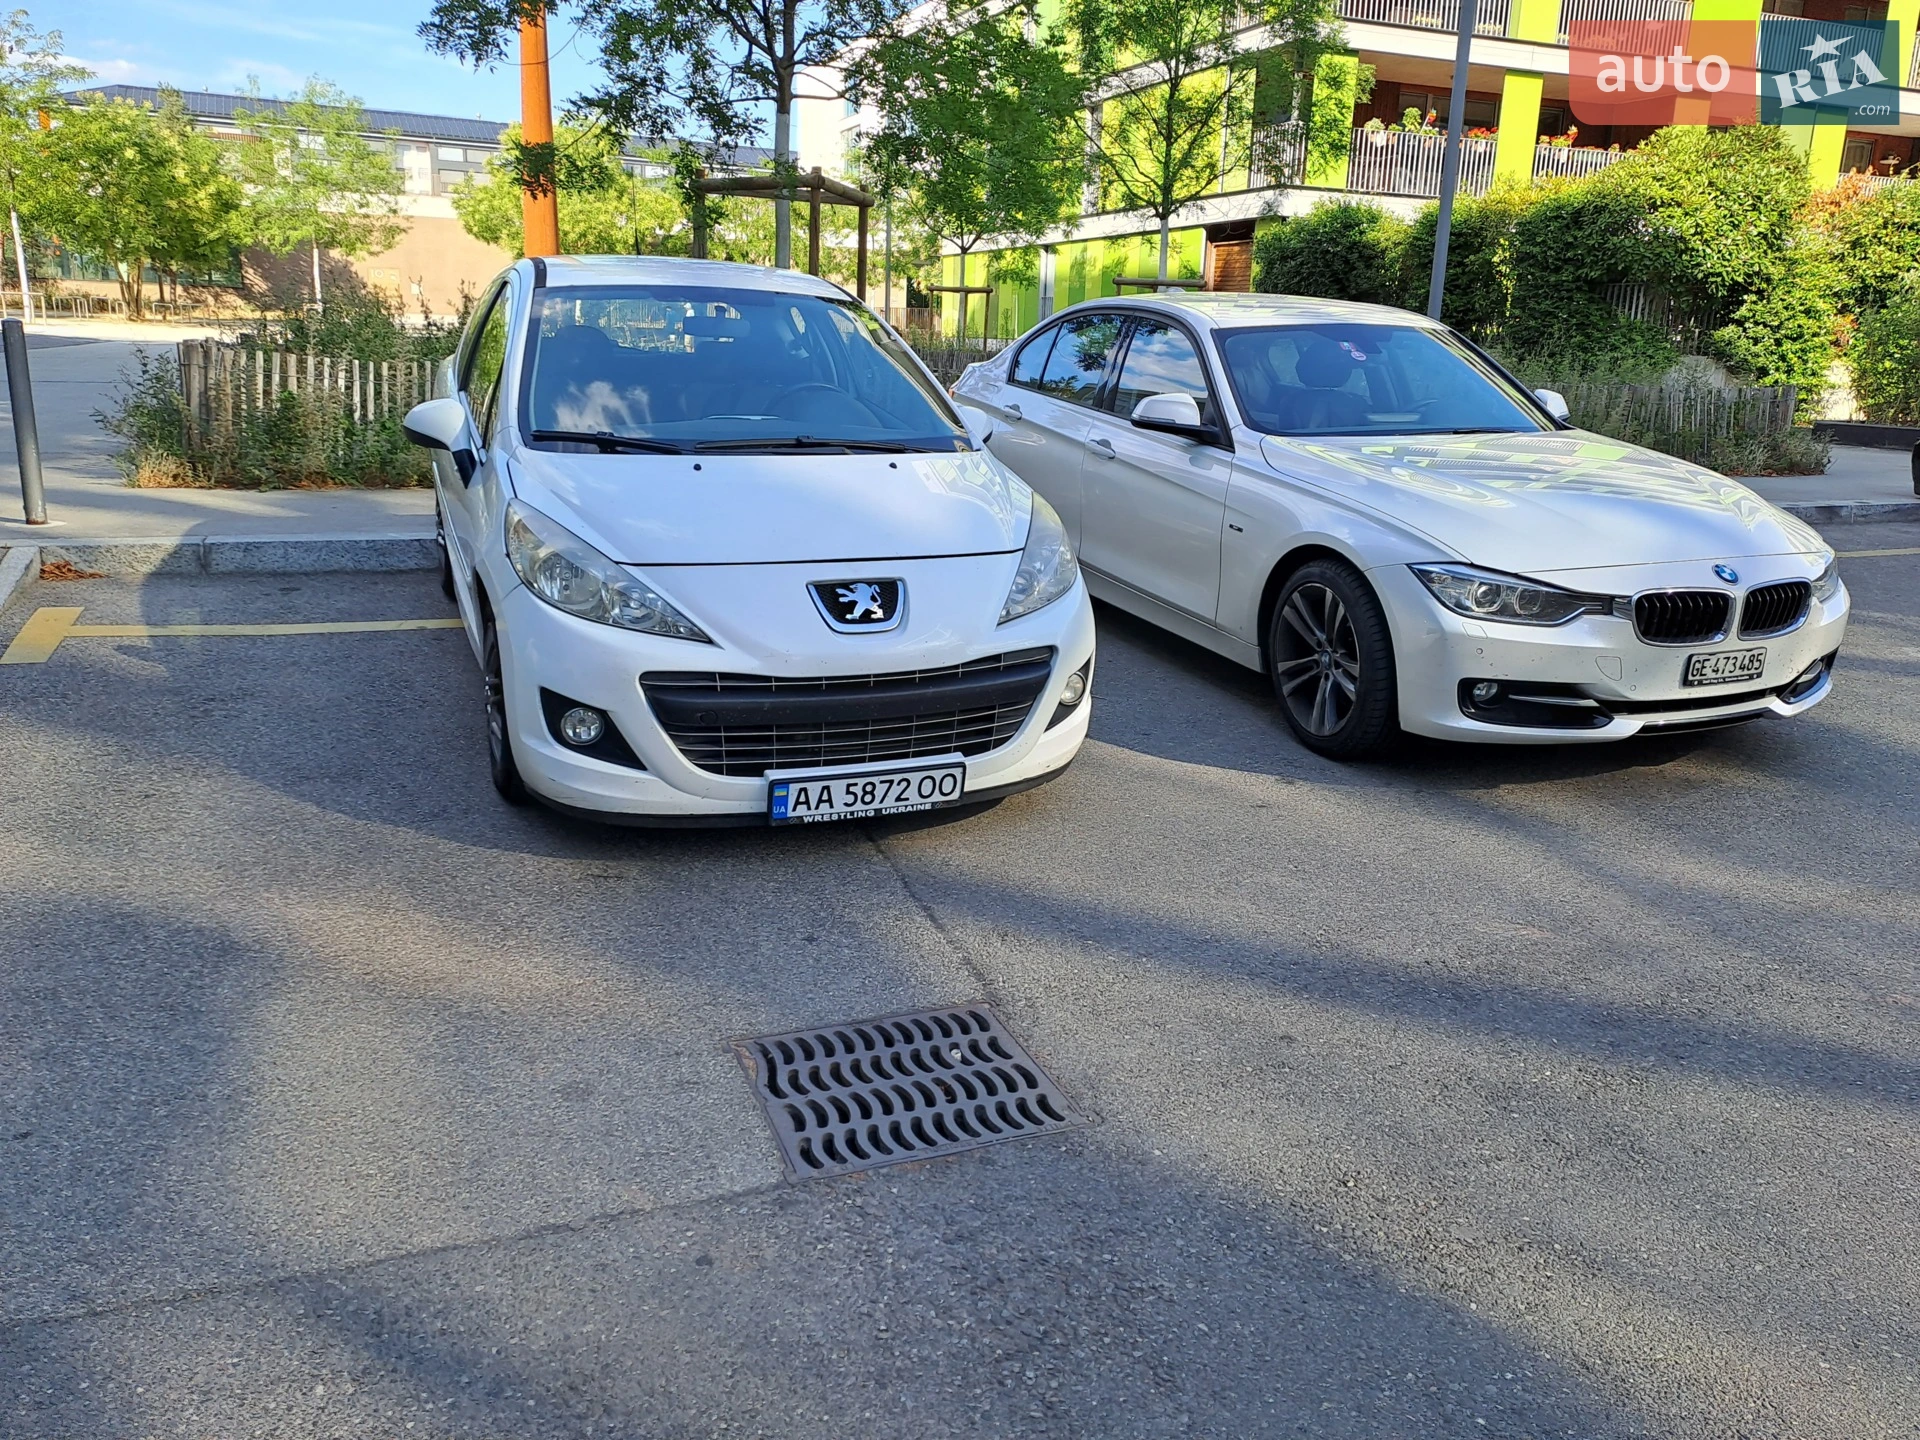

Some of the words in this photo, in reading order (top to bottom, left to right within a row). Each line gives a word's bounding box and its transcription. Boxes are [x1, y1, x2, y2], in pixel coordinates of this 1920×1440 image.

[791, 785, 835, 813] AA
[843, 777, 911, 808] 5872
[773, 805, 786, 814] UA
[803, 809, 875, 823] WRESTLING
[881, 802, 932, 816] UKRAINE
